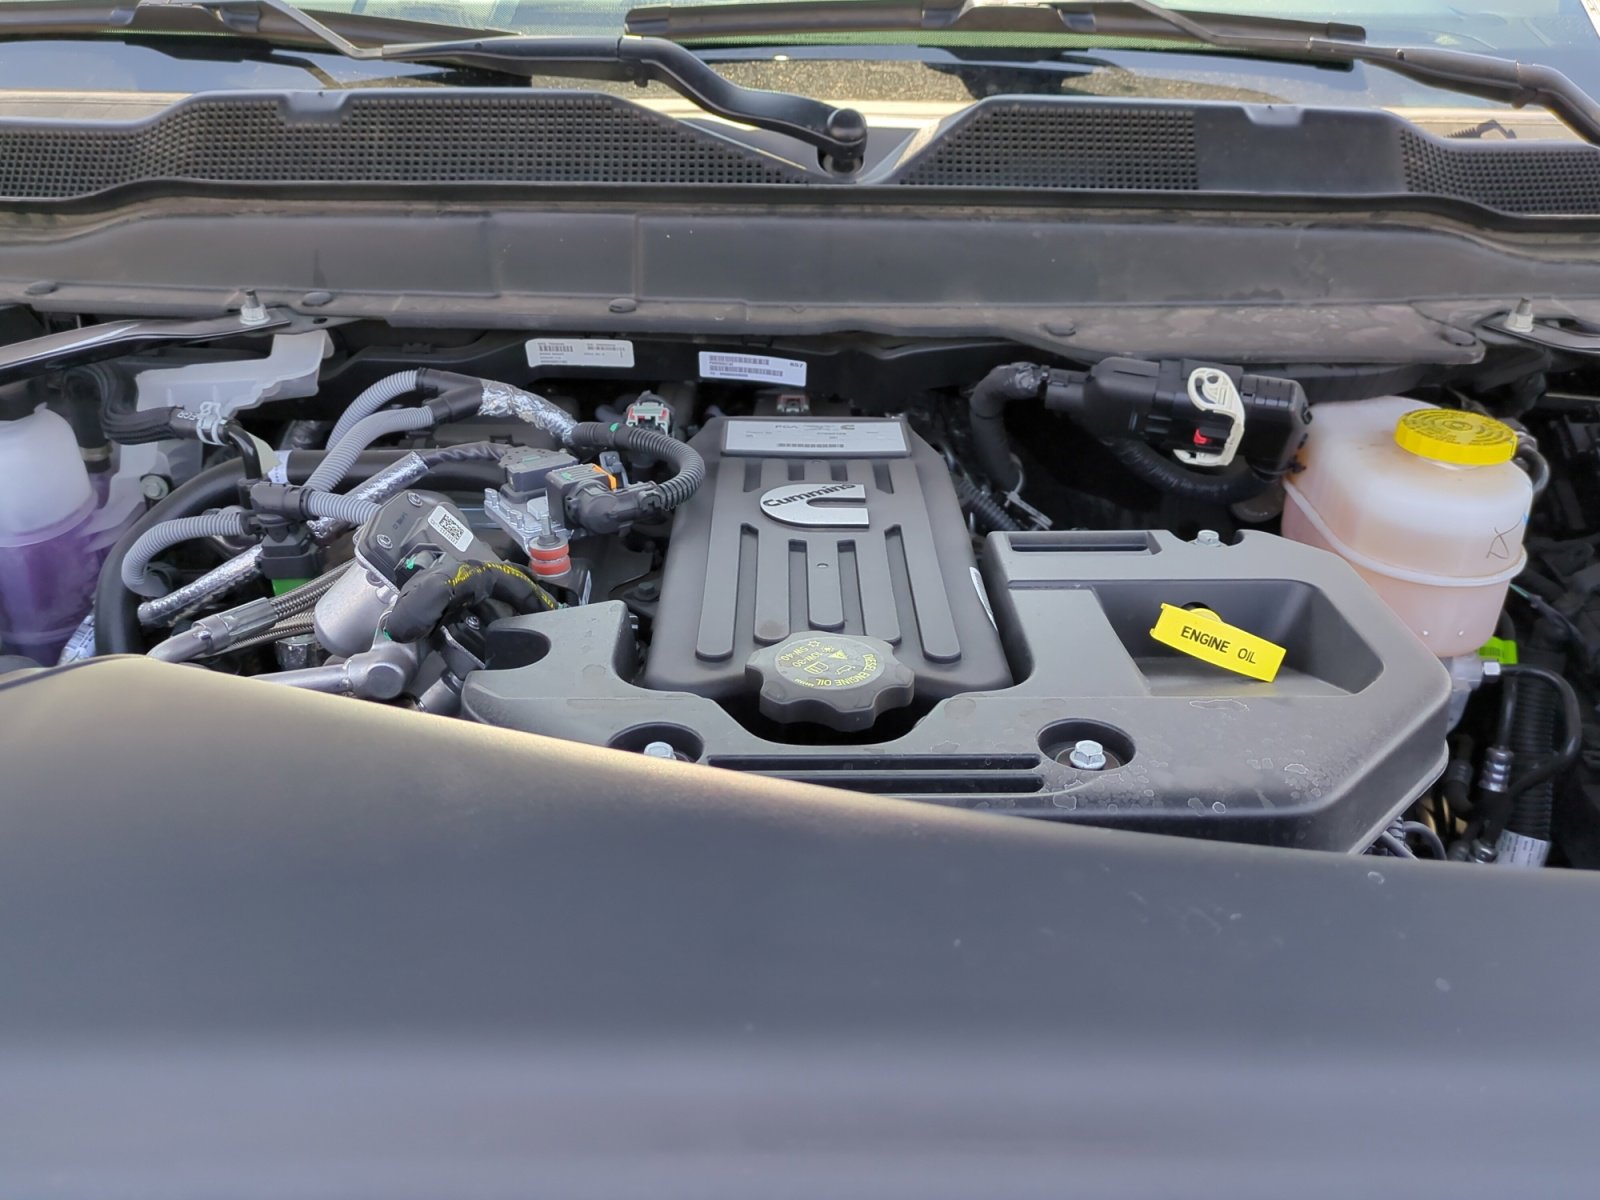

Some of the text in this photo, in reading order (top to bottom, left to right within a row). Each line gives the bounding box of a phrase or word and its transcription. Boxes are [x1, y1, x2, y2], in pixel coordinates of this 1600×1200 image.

[762, 483, 857, 507] Cummins
[1180, 625, 1257, 665] ENGINE OIL
[815, 678, 832, 686] OIL
[834, 671, 871, 687] ENGINE
